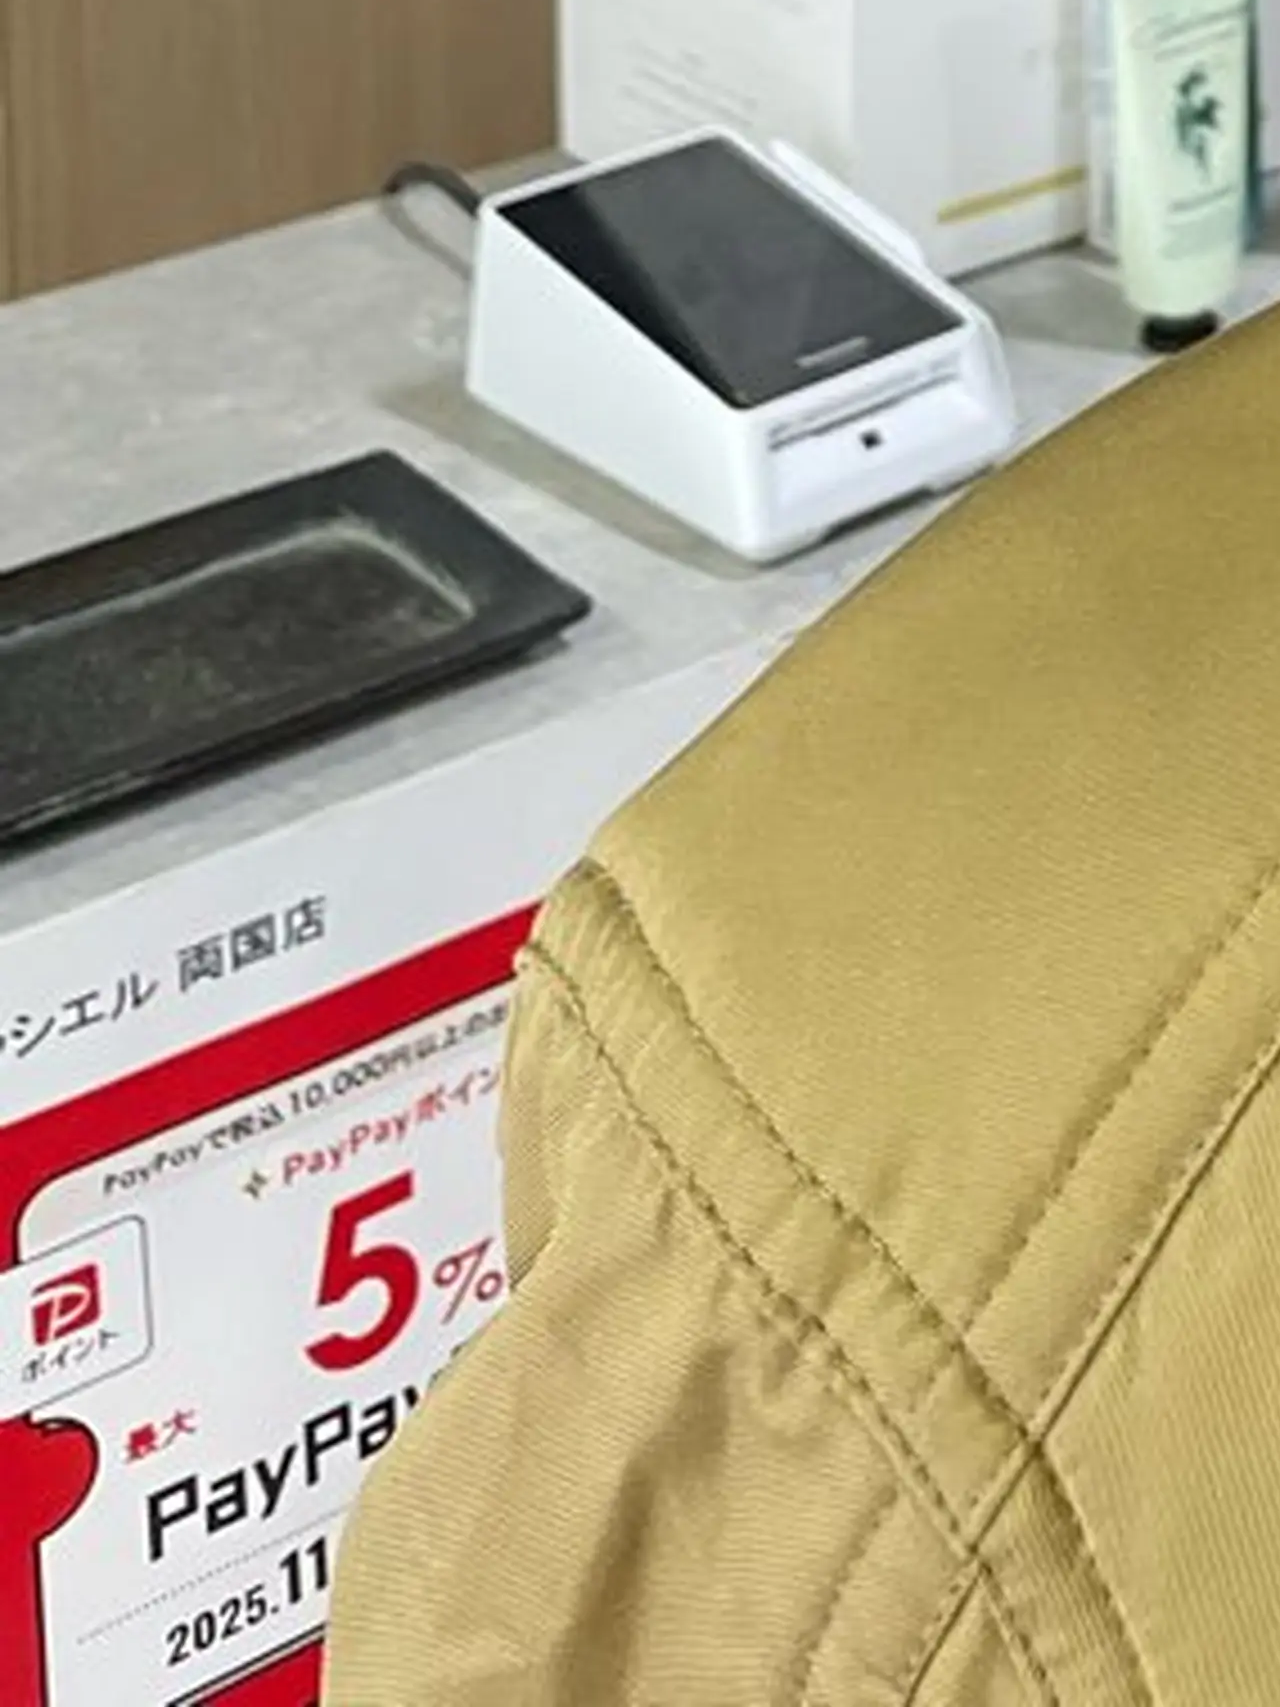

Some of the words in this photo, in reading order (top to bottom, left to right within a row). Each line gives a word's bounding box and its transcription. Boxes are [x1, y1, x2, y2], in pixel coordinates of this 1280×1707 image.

[0, 972, 159, 1058] シエル
[177, 895, 326, 993] 両国店
[304, 1170, 504, 1374] 5%
[21, 1329, 121, 1383] ポイント
[124, 1407, 196, 1463] 最大
